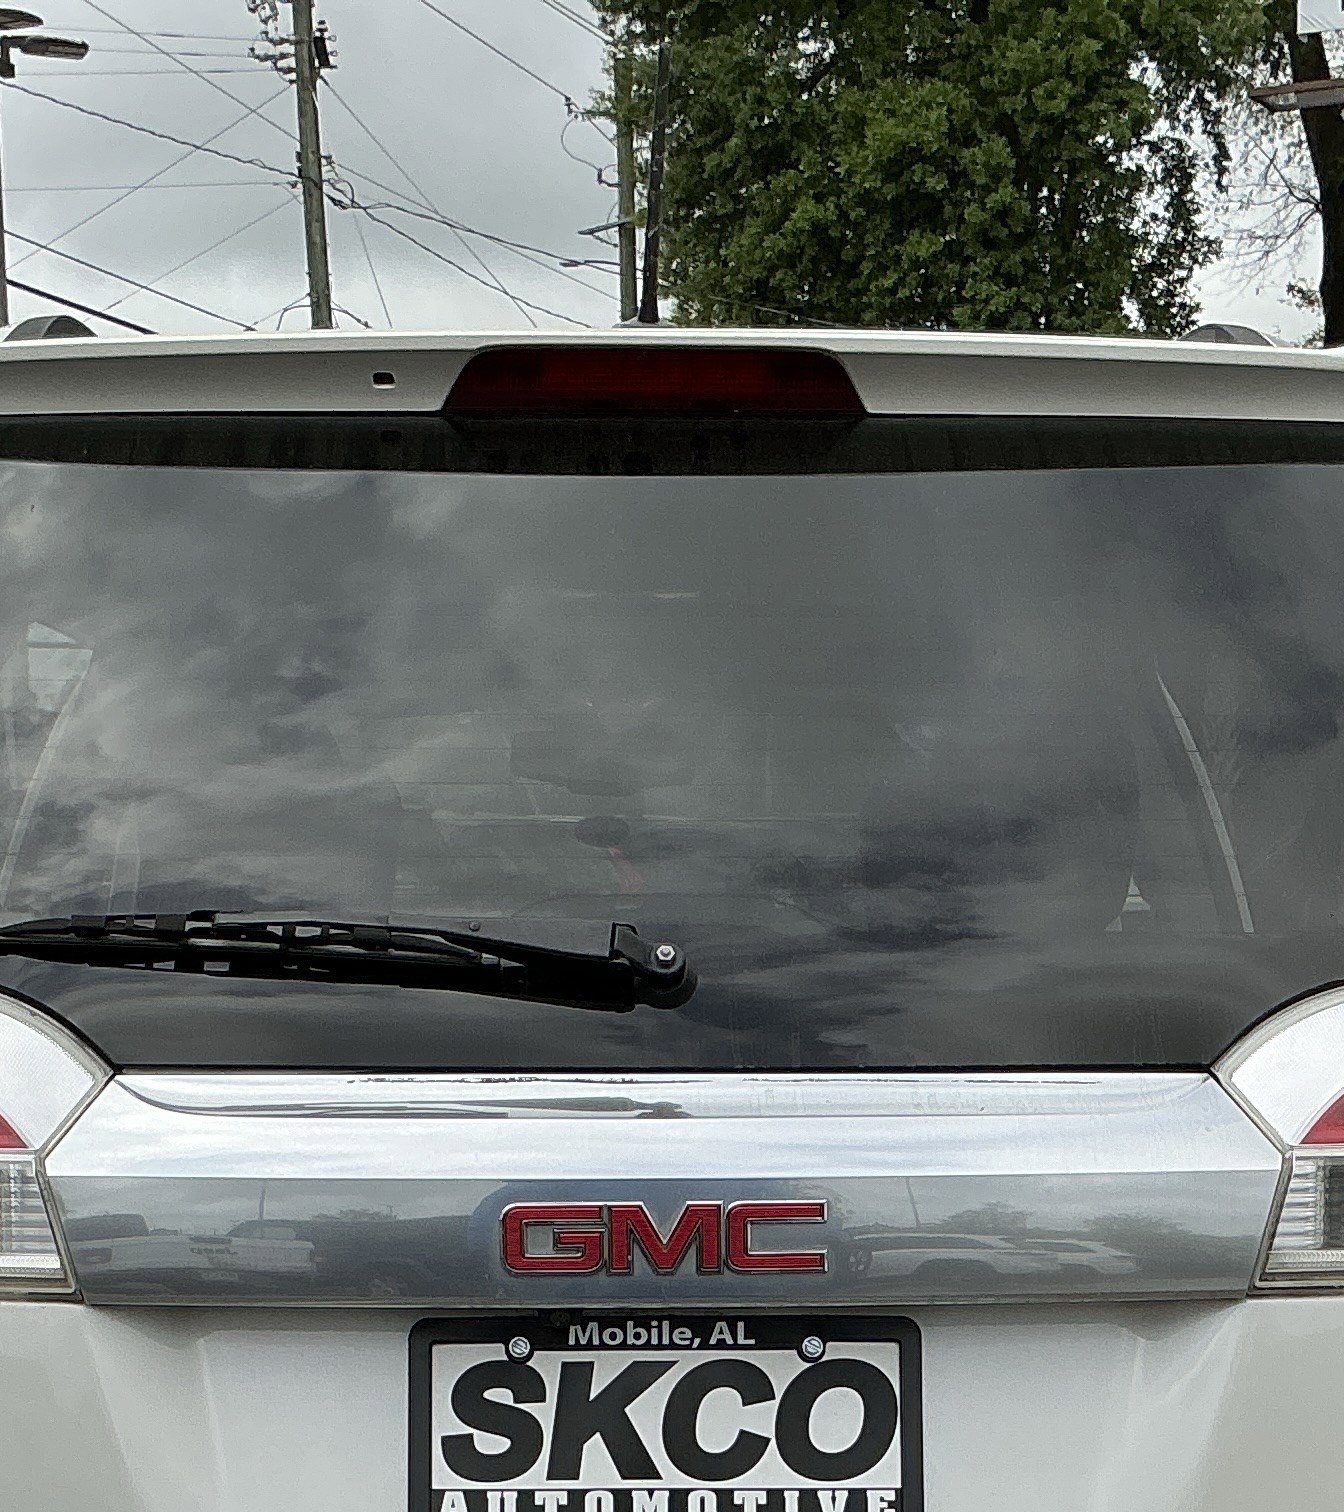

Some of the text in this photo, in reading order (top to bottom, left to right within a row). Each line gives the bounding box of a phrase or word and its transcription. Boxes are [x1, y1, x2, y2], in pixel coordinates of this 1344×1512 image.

[500, 1199, 829, 1275] GMC
[567, 1321, 756, 1348] Mobile, AL
[440, 1357, 899, 1483] SKCO
